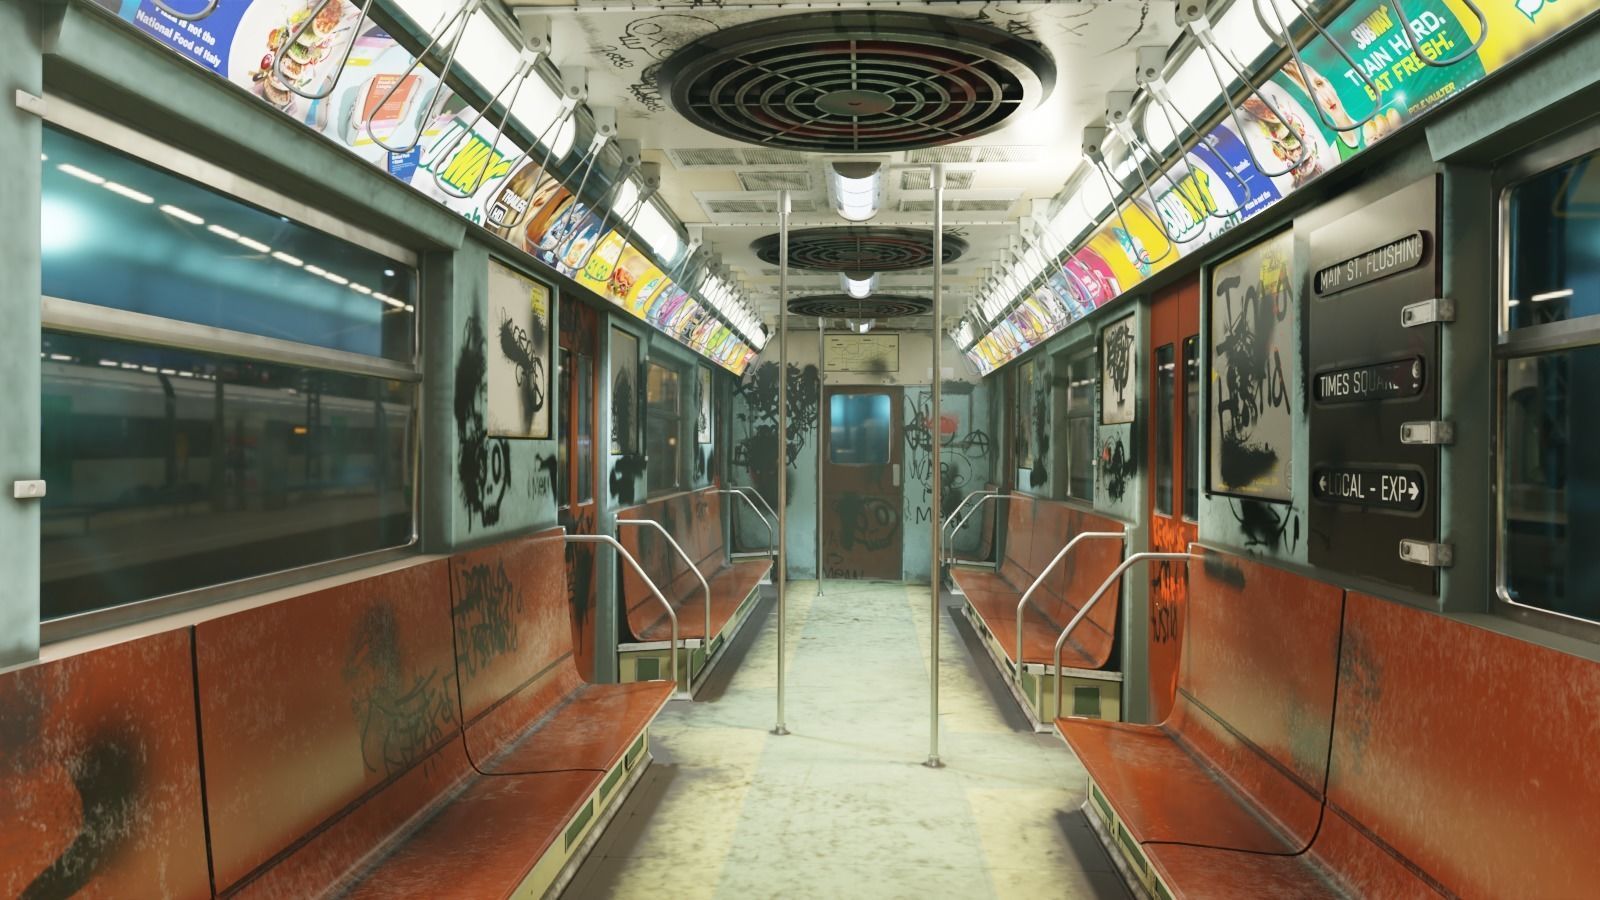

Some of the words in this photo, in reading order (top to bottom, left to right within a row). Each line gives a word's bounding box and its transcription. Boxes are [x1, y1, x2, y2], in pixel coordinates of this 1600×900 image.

[136, 10, 174, 39] National
[173, 31, 195, 51] Food
[193, 46, 204, 56] of
[203, 49, 222, 68] Italy
[187, 23, 203, 38] not
[202, 30, 216, 46] the
[1351, 5, 1394, 51] SUBWAY
[1344, 46, 1394, 88] TRAIN
[1388, 10, 1447, 56] HARD.
[1363, 70, 1394, 102] EAT
[1425, 82, 1456, 106] VAULTER
[491, 207, 504, 223] HD
[1320, 265, 1341, 291] MAIN
[1347, 257, 1362, 281] ST.
[1320, 372, 1349, 398] TIMES
[1328, 472, 1365, 499] LOCAL
[1381, 474, 1407, 503] EXP
